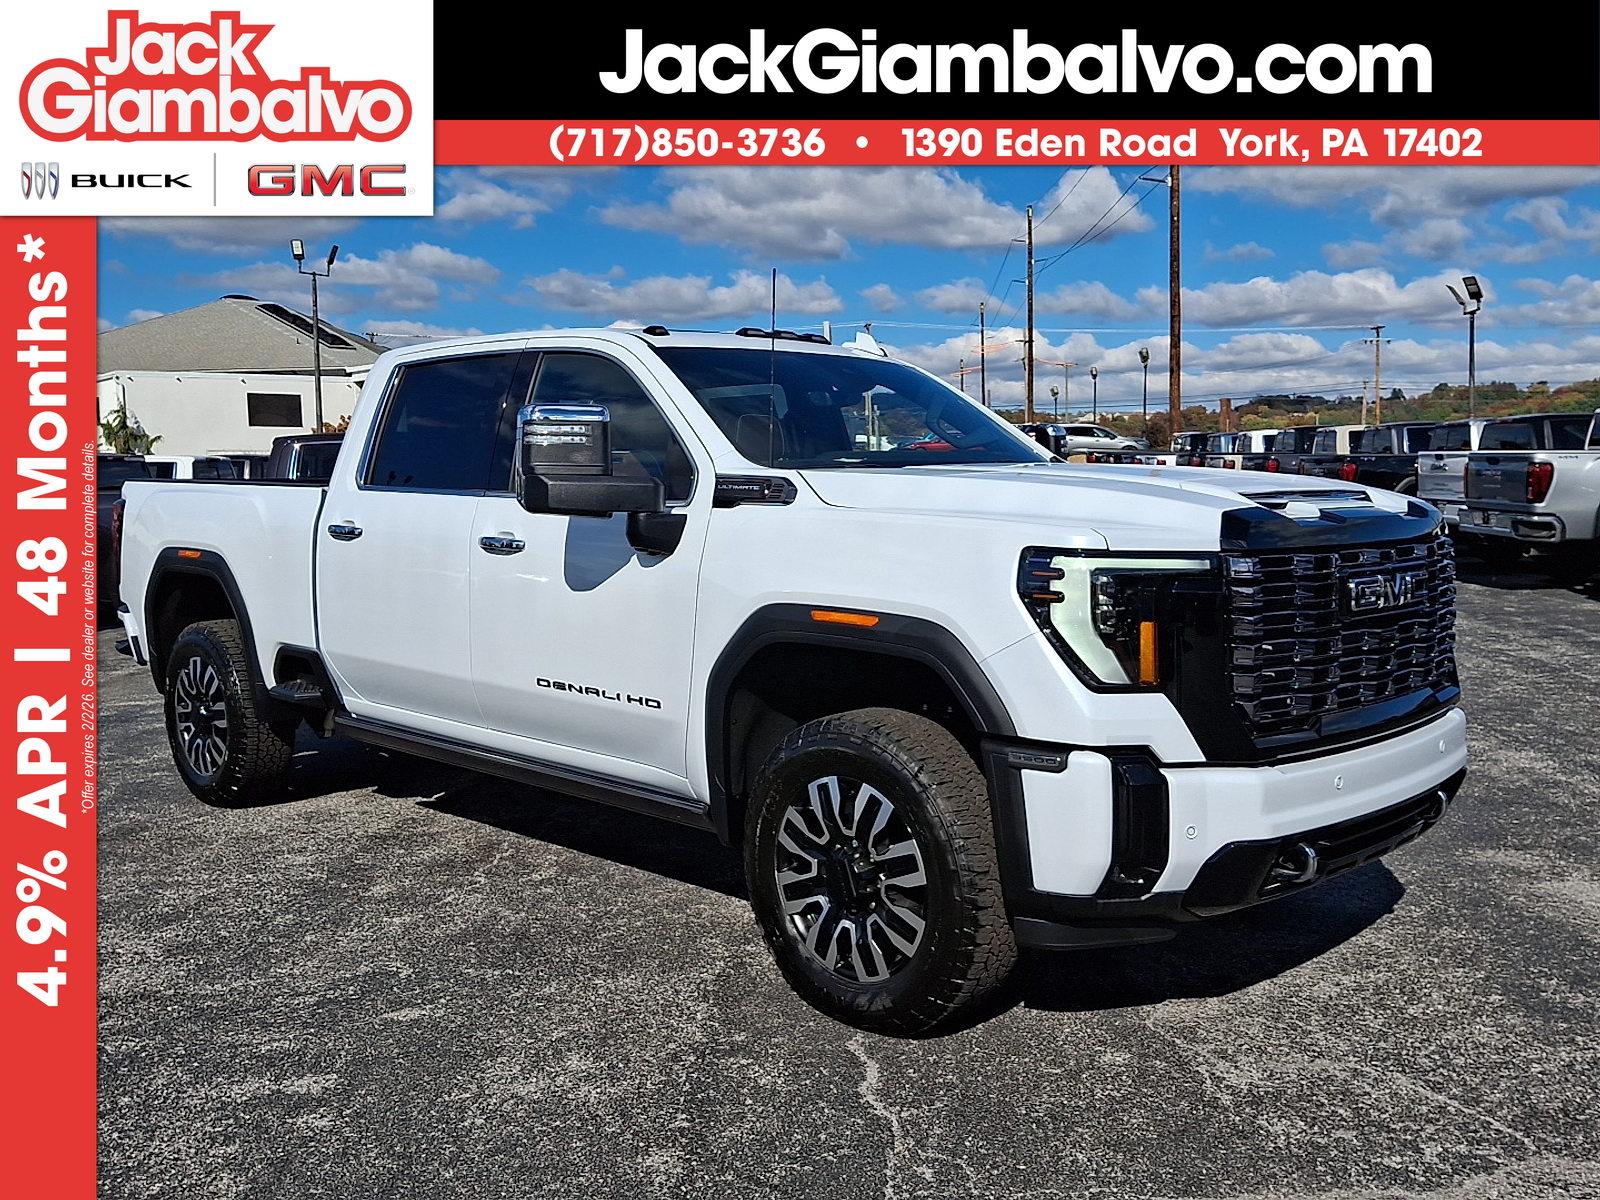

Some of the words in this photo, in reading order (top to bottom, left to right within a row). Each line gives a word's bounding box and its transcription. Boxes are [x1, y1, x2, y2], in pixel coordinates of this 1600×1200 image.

[1348, 572, 1428, 611] GMC
[536, 677, 621, 702] DENALI
[626, 694, 662, 709] HD
